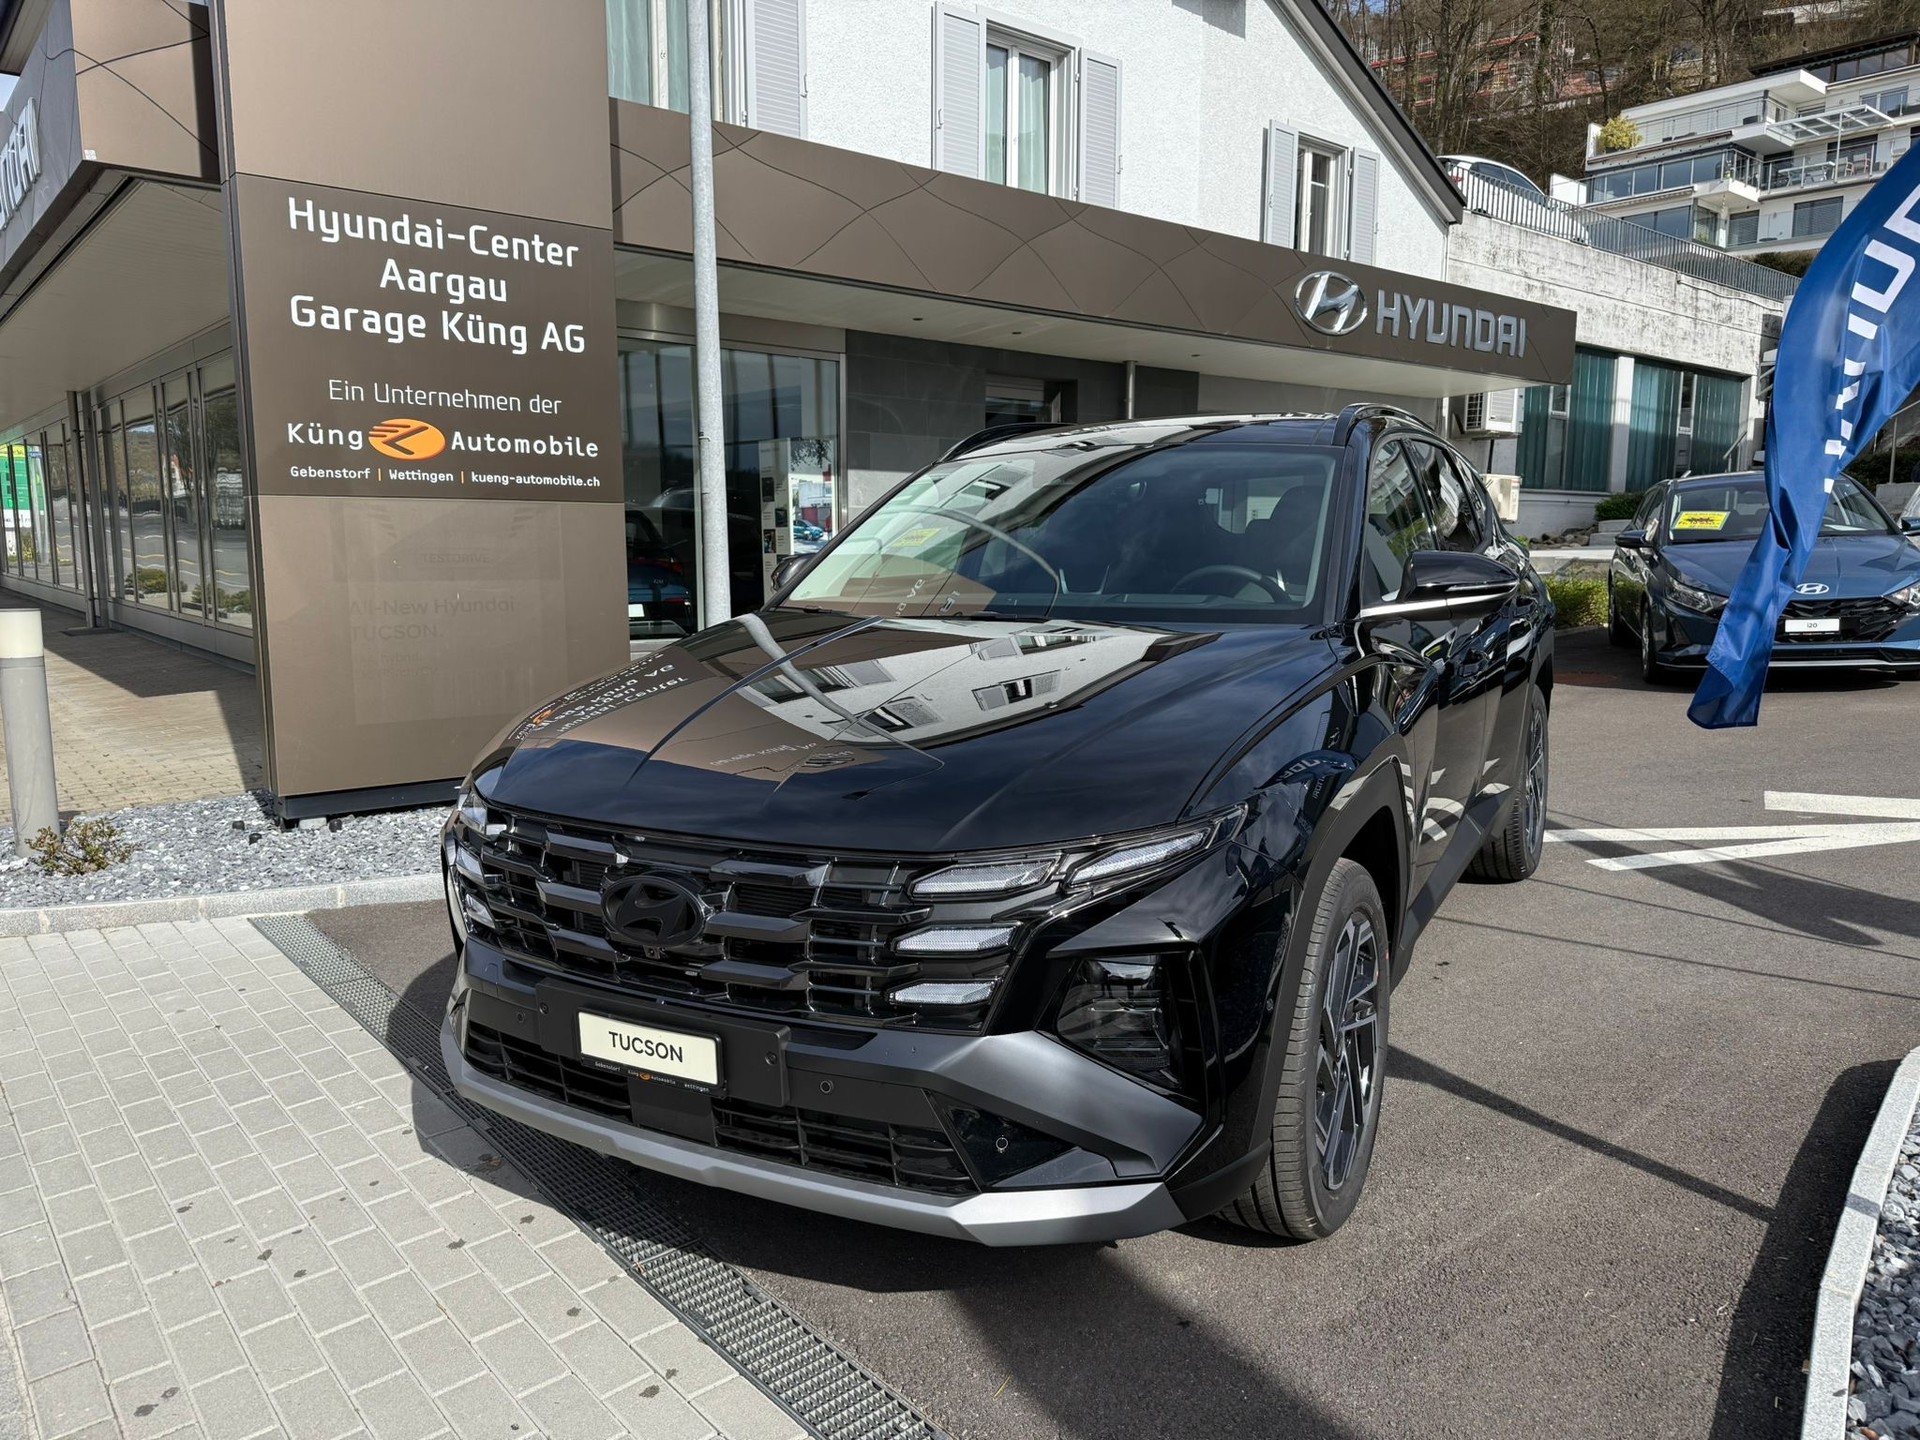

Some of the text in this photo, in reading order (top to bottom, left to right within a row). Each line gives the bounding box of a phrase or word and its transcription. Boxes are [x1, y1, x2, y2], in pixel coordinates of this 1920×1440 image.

[0, 97, 41, 231] NDAI
[288, 197, 579, 267] Hyundai-Center
[380, 258, 507, 304] Aargau
[290, 295, 585, 355] Garage Küng AG
[1376, 290, 1526, 358] HYUNDAI
[328, 379, 562, 415] Ein Unternehmen der
[287, 423, 599, 457] Küng Automobile
[290, 465, 600, 487] Gebenstorf Wettingen kueng-automobile.ch
[434, 596, 515, 616] Hyundai
[608, 1031, 683, 1063] TUCSON
